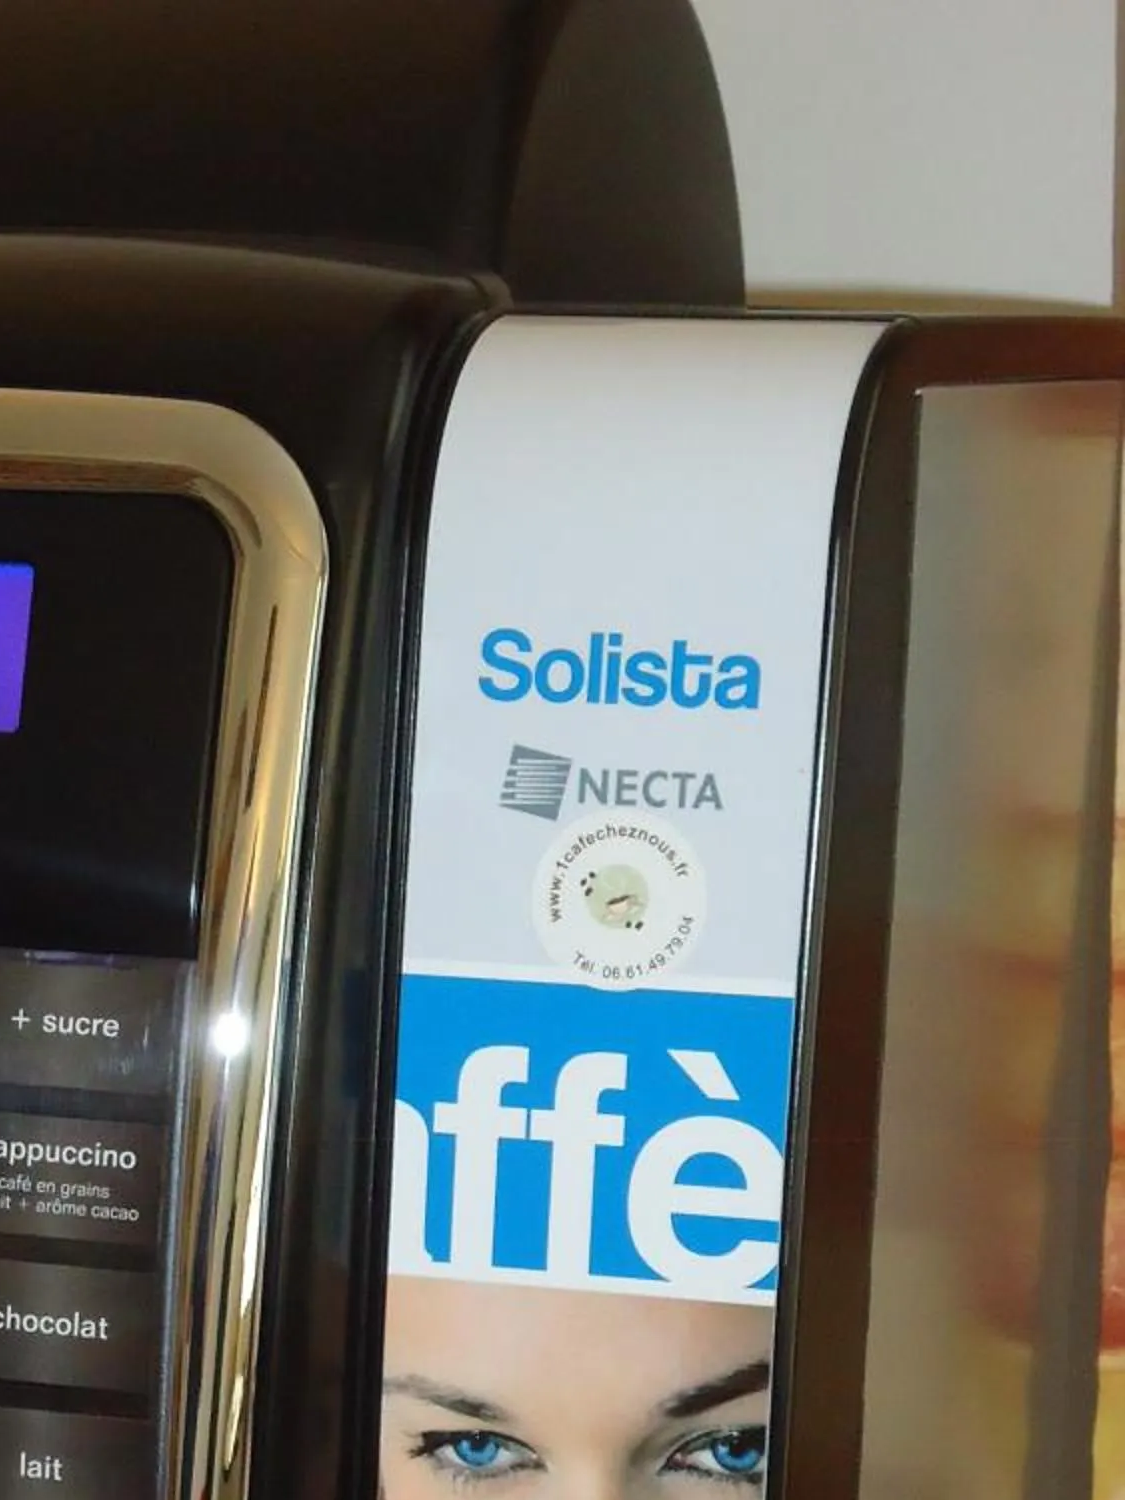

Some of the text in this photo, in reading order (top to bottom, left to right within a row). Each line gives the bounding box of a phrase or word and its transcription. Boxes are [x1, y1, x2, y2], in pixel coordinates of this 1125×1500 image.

[479, 627, 760, 710] Solista
[577, 767, 723, 810] NECTA
[42, 1012, 120, 1037] sucre
[36, 1179, 56, 1194] en
[60, 1178, 110, 1199] grains
[35, 1197, 87, 1217] arôme
[91, 1205, 139, 1221] cacao
[20, 1452, 63, 1481] lait
